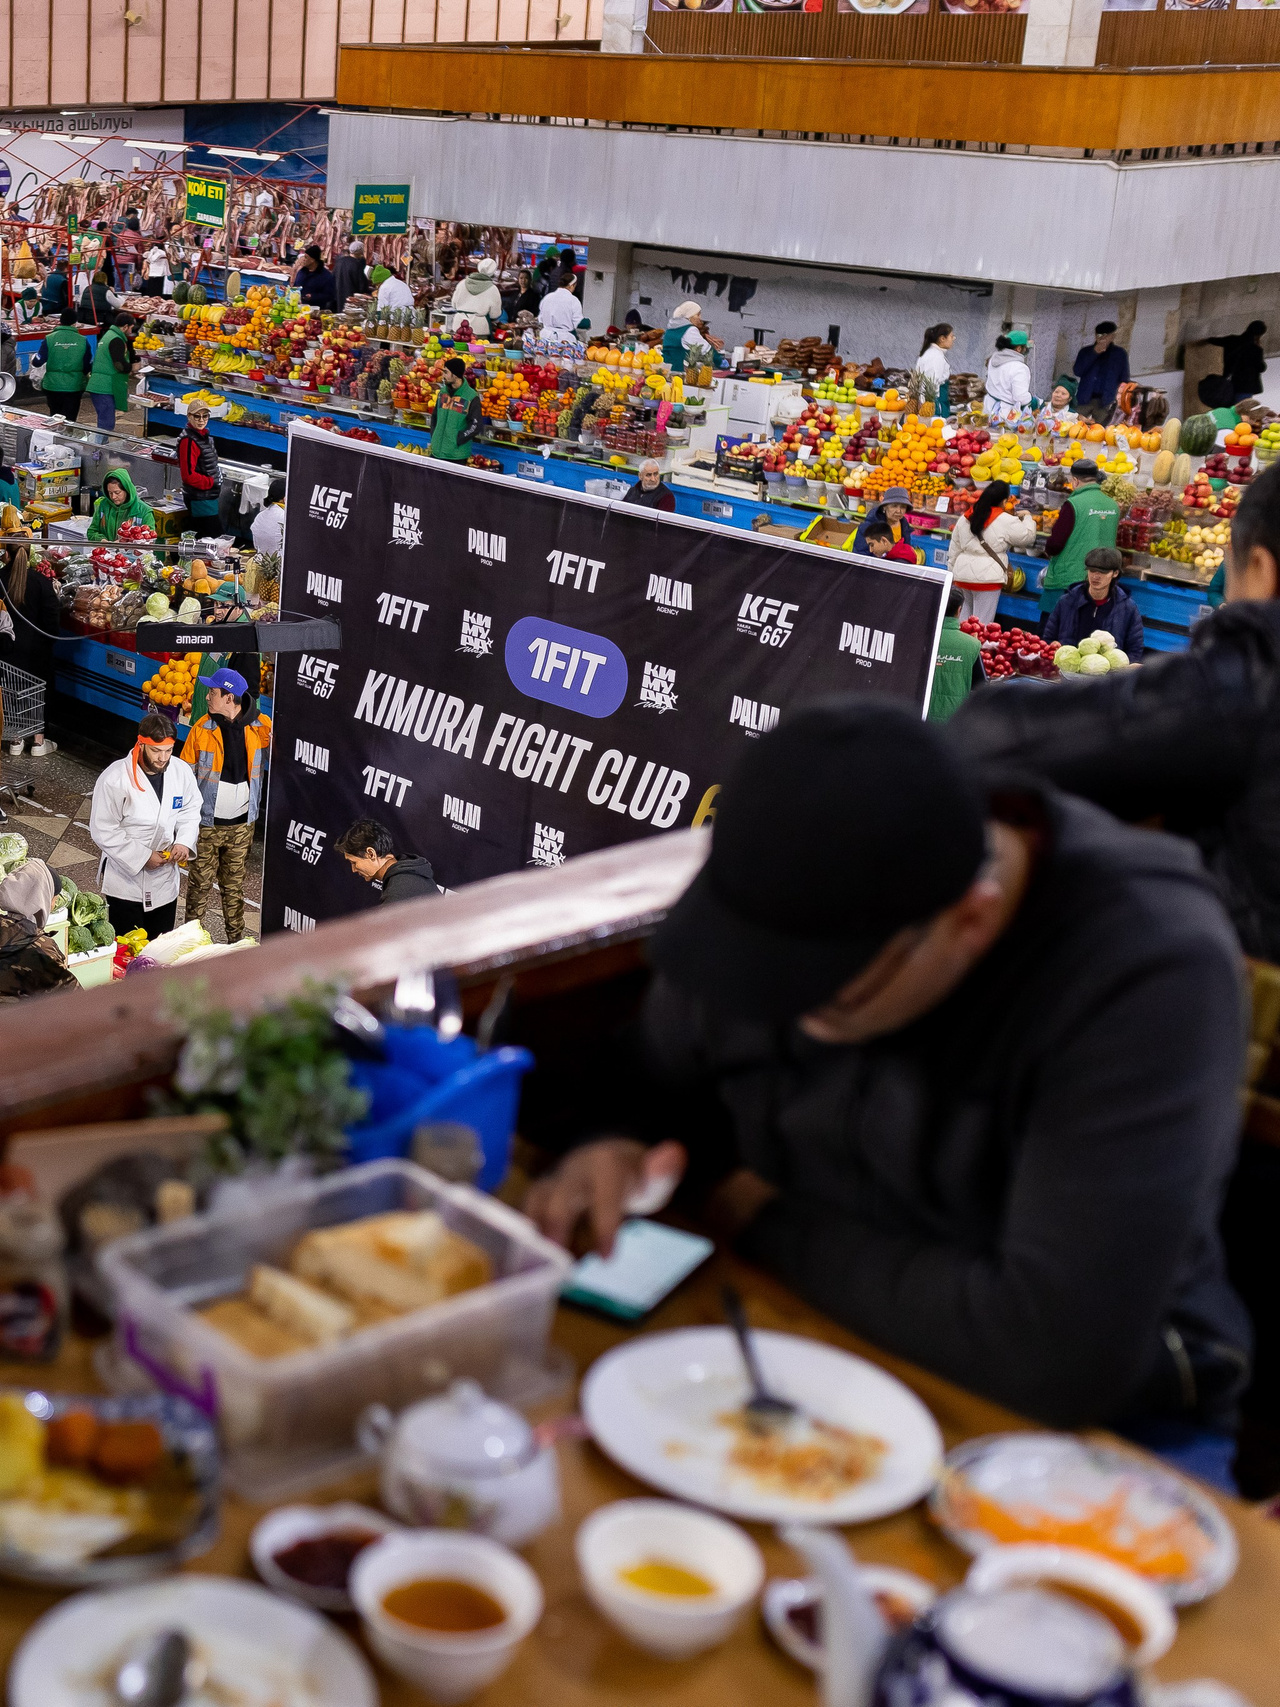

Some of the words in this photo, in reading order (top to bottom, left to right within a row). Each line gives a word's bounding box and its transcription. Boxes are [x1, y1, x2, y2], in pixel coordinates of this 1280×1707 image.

[69, 116, 133, 133] ашылуы
[310, 484, 353, 514] KFC
[325, 510, 348, 530] 667
[468, 527, 507, 563] PALM
[480, 558, 493, 567] PROD
[546, 549, 606, 594] 1FIT
[306, 570, 343, 603] PALM
[645, 573, 693, 611] PALM
[376, 592, 430, 634] 1FIT
[656, 605, 680, 616] AGENCY
[737, 593, 800, 630] KFC
[175, 635, 214, 644] amaran
[759, 625, 793, 649] 667
[838, 621, 896, 664] PALM
[298, 653, 340, 685] KFC
[527, 637, 608, 696] 1FIT
[855, 657, 872, 668] PROD
[313, 680, 335, 700] 667
[294, 738, 330, 773] PALM
[353, 668, 484, 759] KIMURA
[482, 712, 594, 794] FIGHT
[586, 748, 691, 829] CLUB
[305, 766, 317, 775] PROD
[361, 765, 413, 808] 1FIT
[442, 793, 482, 831] PALM
[451, 822, 470, 834] AGENCY
[286, 819, 327, 852] KFC
[301, 846, 322, 866] 667
